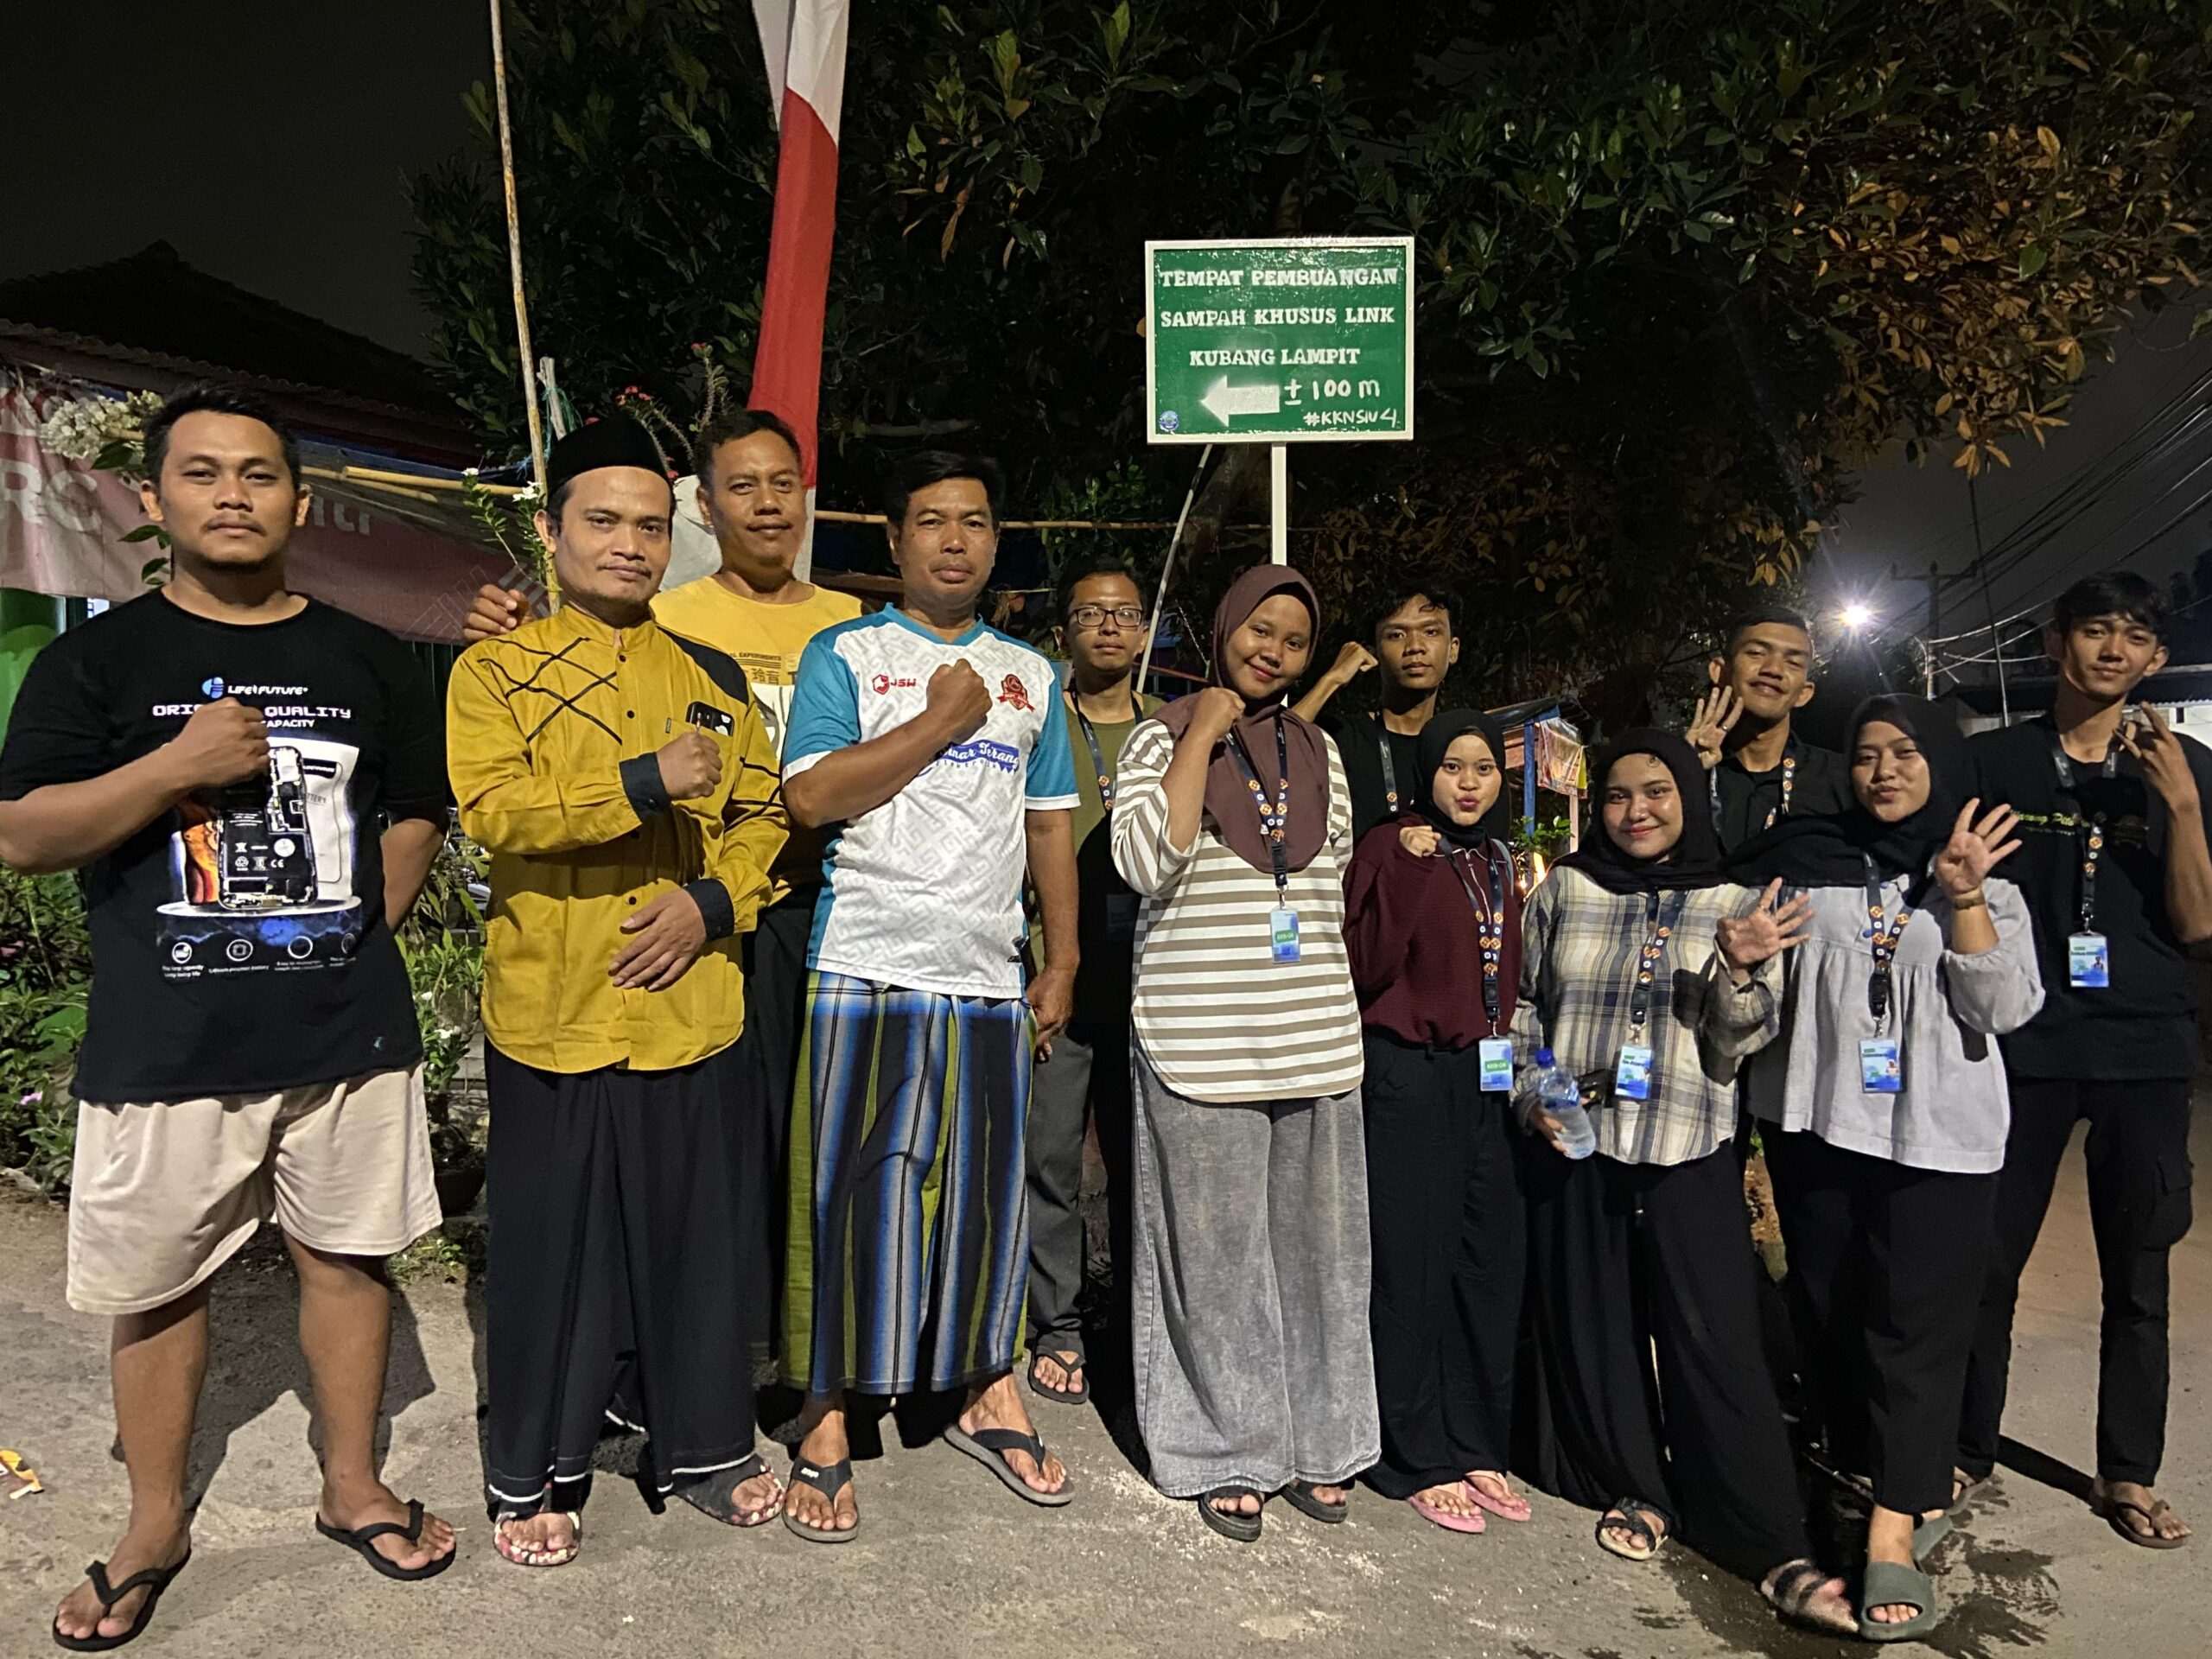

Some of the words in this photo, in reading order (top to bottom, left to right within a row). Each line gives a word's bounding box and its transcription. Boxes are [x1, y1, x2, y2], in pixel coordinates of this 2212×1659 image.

[1160, 270, 1244, 288] TEMPAT
[1251, 267, 1399, 287] PEMBUANGAN
[1160, 308, 1246, 327] SAMPAH
[1254, 308, 1337, 325] KHUSUS
[1344, 307, 1395, 324] LINK
[1189, 349, 1275, 366] KUBANG
[1281, 348, 1361, 365] LAMPIT
[1313, 378, 1351, 400] 100
[264, 706, 351, 719] QUALITY
